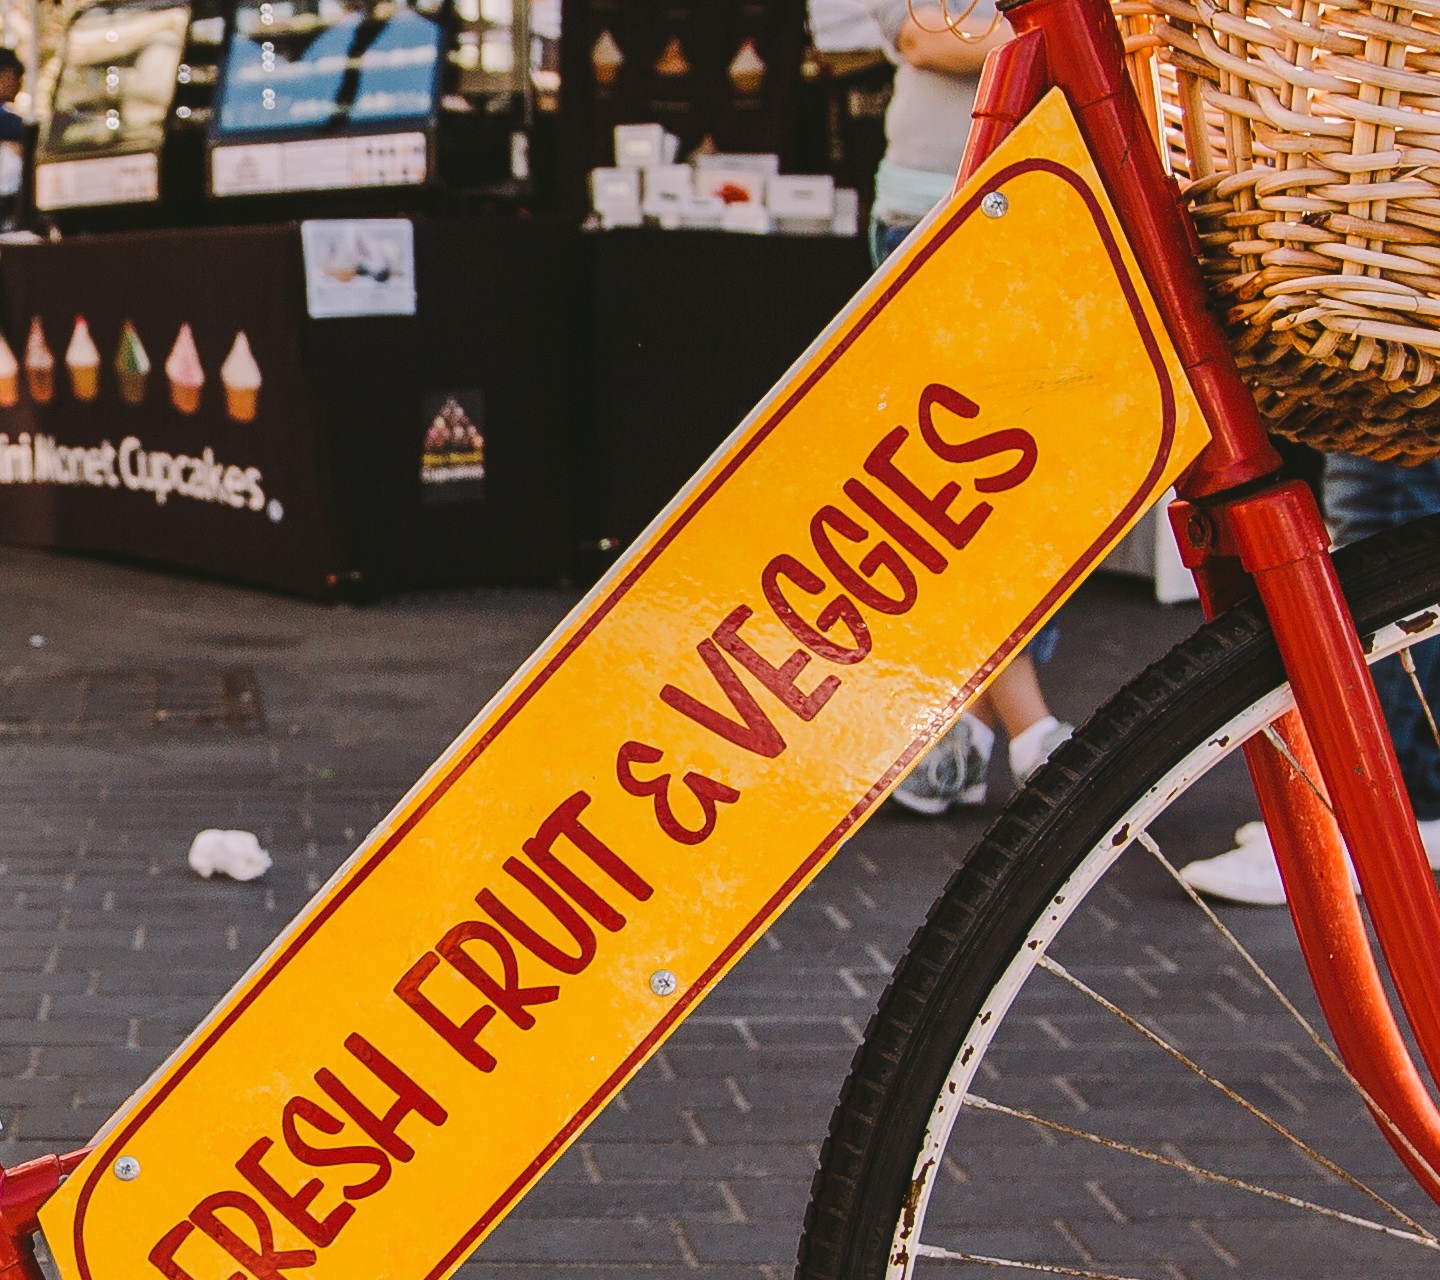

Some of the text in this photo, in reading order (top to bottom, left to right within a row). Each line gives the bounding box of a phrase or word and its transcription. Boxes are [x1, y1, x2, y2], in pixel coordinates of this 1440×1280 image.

[659, 383, 1038, 759] VEGGIES
[393, 790, 655, 1074] FRUIT
[616, 740, 741, 846] &
